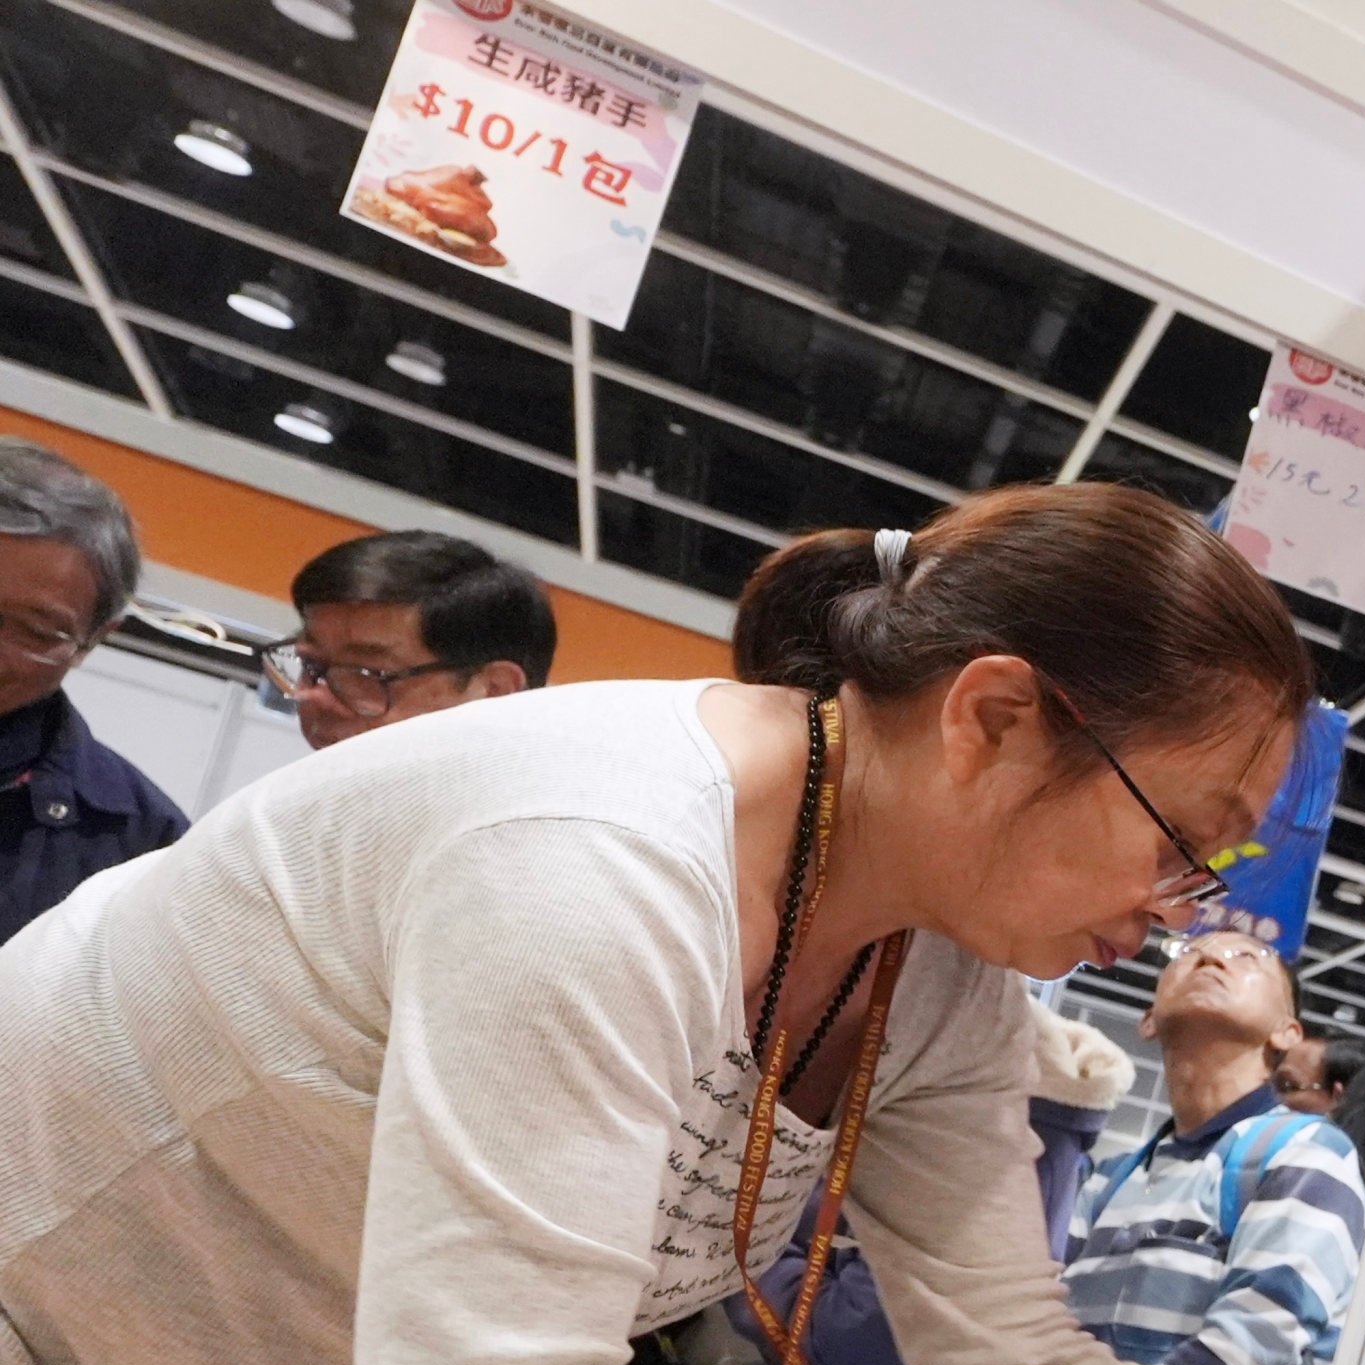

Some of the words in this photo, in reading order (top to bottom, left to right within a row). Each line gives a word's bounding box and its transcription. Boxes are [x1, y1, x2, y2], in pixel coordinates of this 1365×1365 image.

[411, 82, 633, 207] $10/1包
[757, 1075, 779, 1119] KONG
[746, 1121, 771, 1165] FOOD
[736, 1165, 766, 1231] FESTIVAL
